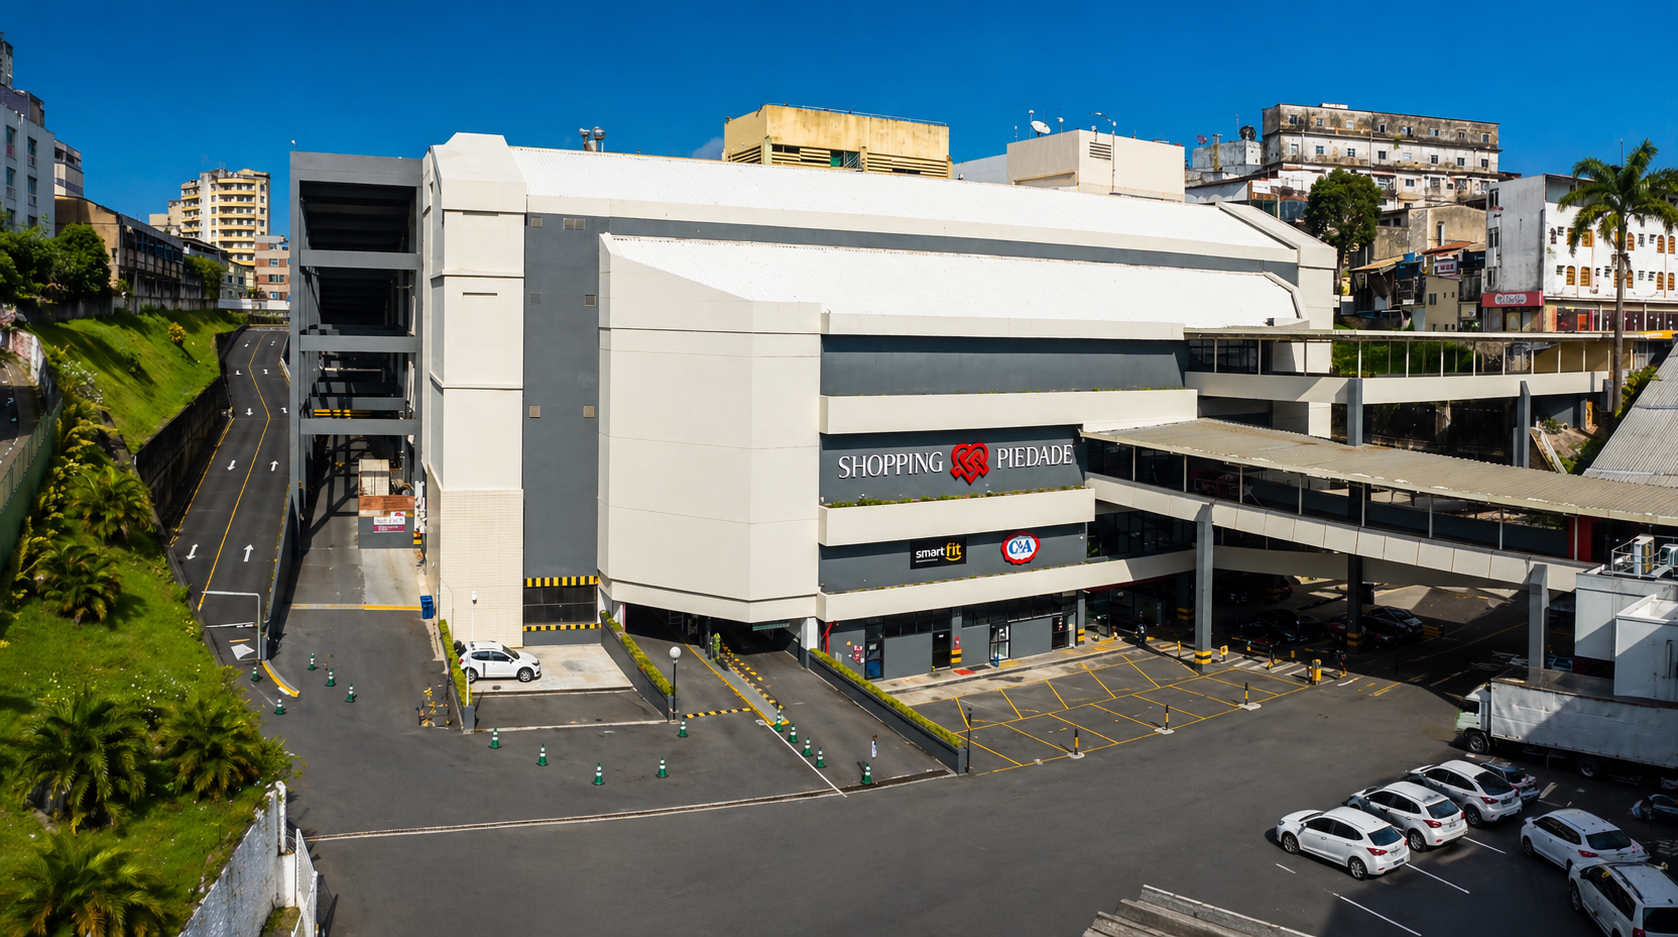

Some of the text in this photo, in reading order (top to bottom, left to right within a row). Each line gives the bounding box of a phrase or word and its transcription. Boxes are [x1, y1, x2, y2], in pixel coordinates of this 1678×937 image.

[838, 444, 1073, 479] SHOPPING PIEDADE
[915, 542, 962, 559] smart fit
[1008, 539, 1033, 555] C&A
